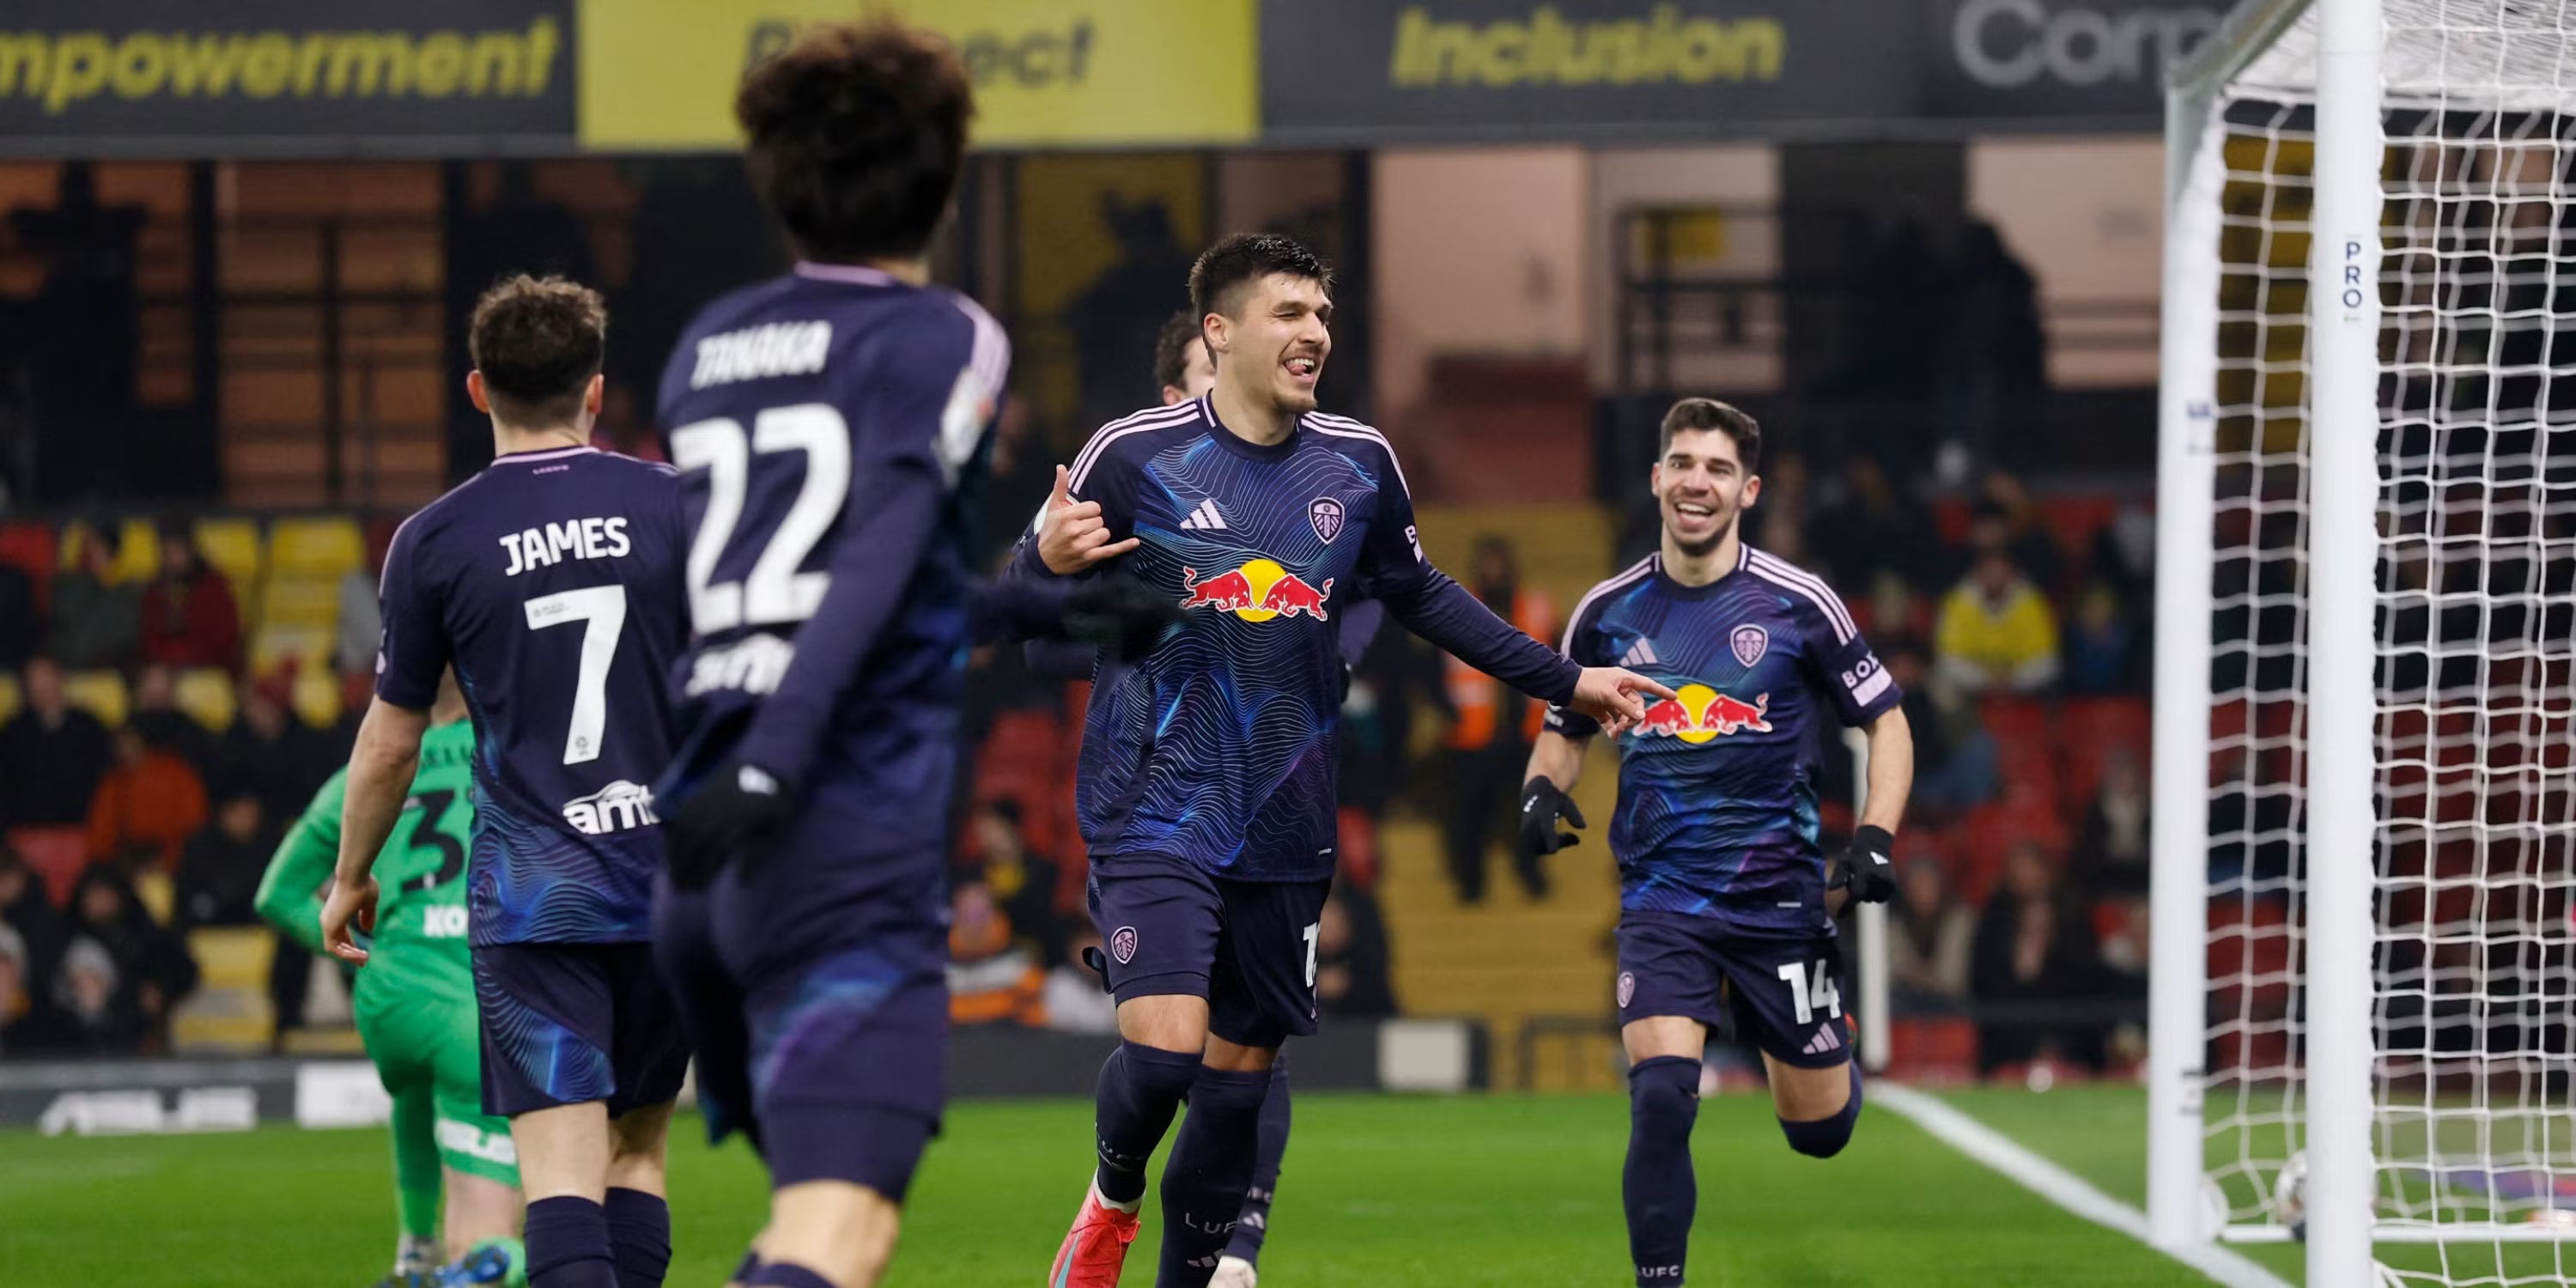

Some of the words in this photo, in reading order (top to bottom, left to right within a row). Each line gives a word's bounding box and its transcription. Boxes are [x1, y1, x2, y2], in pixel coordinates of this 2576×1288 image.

[1391, 7, 1785, 84] Inclusion
[2342, 240, 2363, 309] PRO
[499, 516, 631, 577] JAMES
[670, 402, 852, 636] 22
[523, 584, 628, 766] 7
[1777, 957, 1842, 1025] 14
